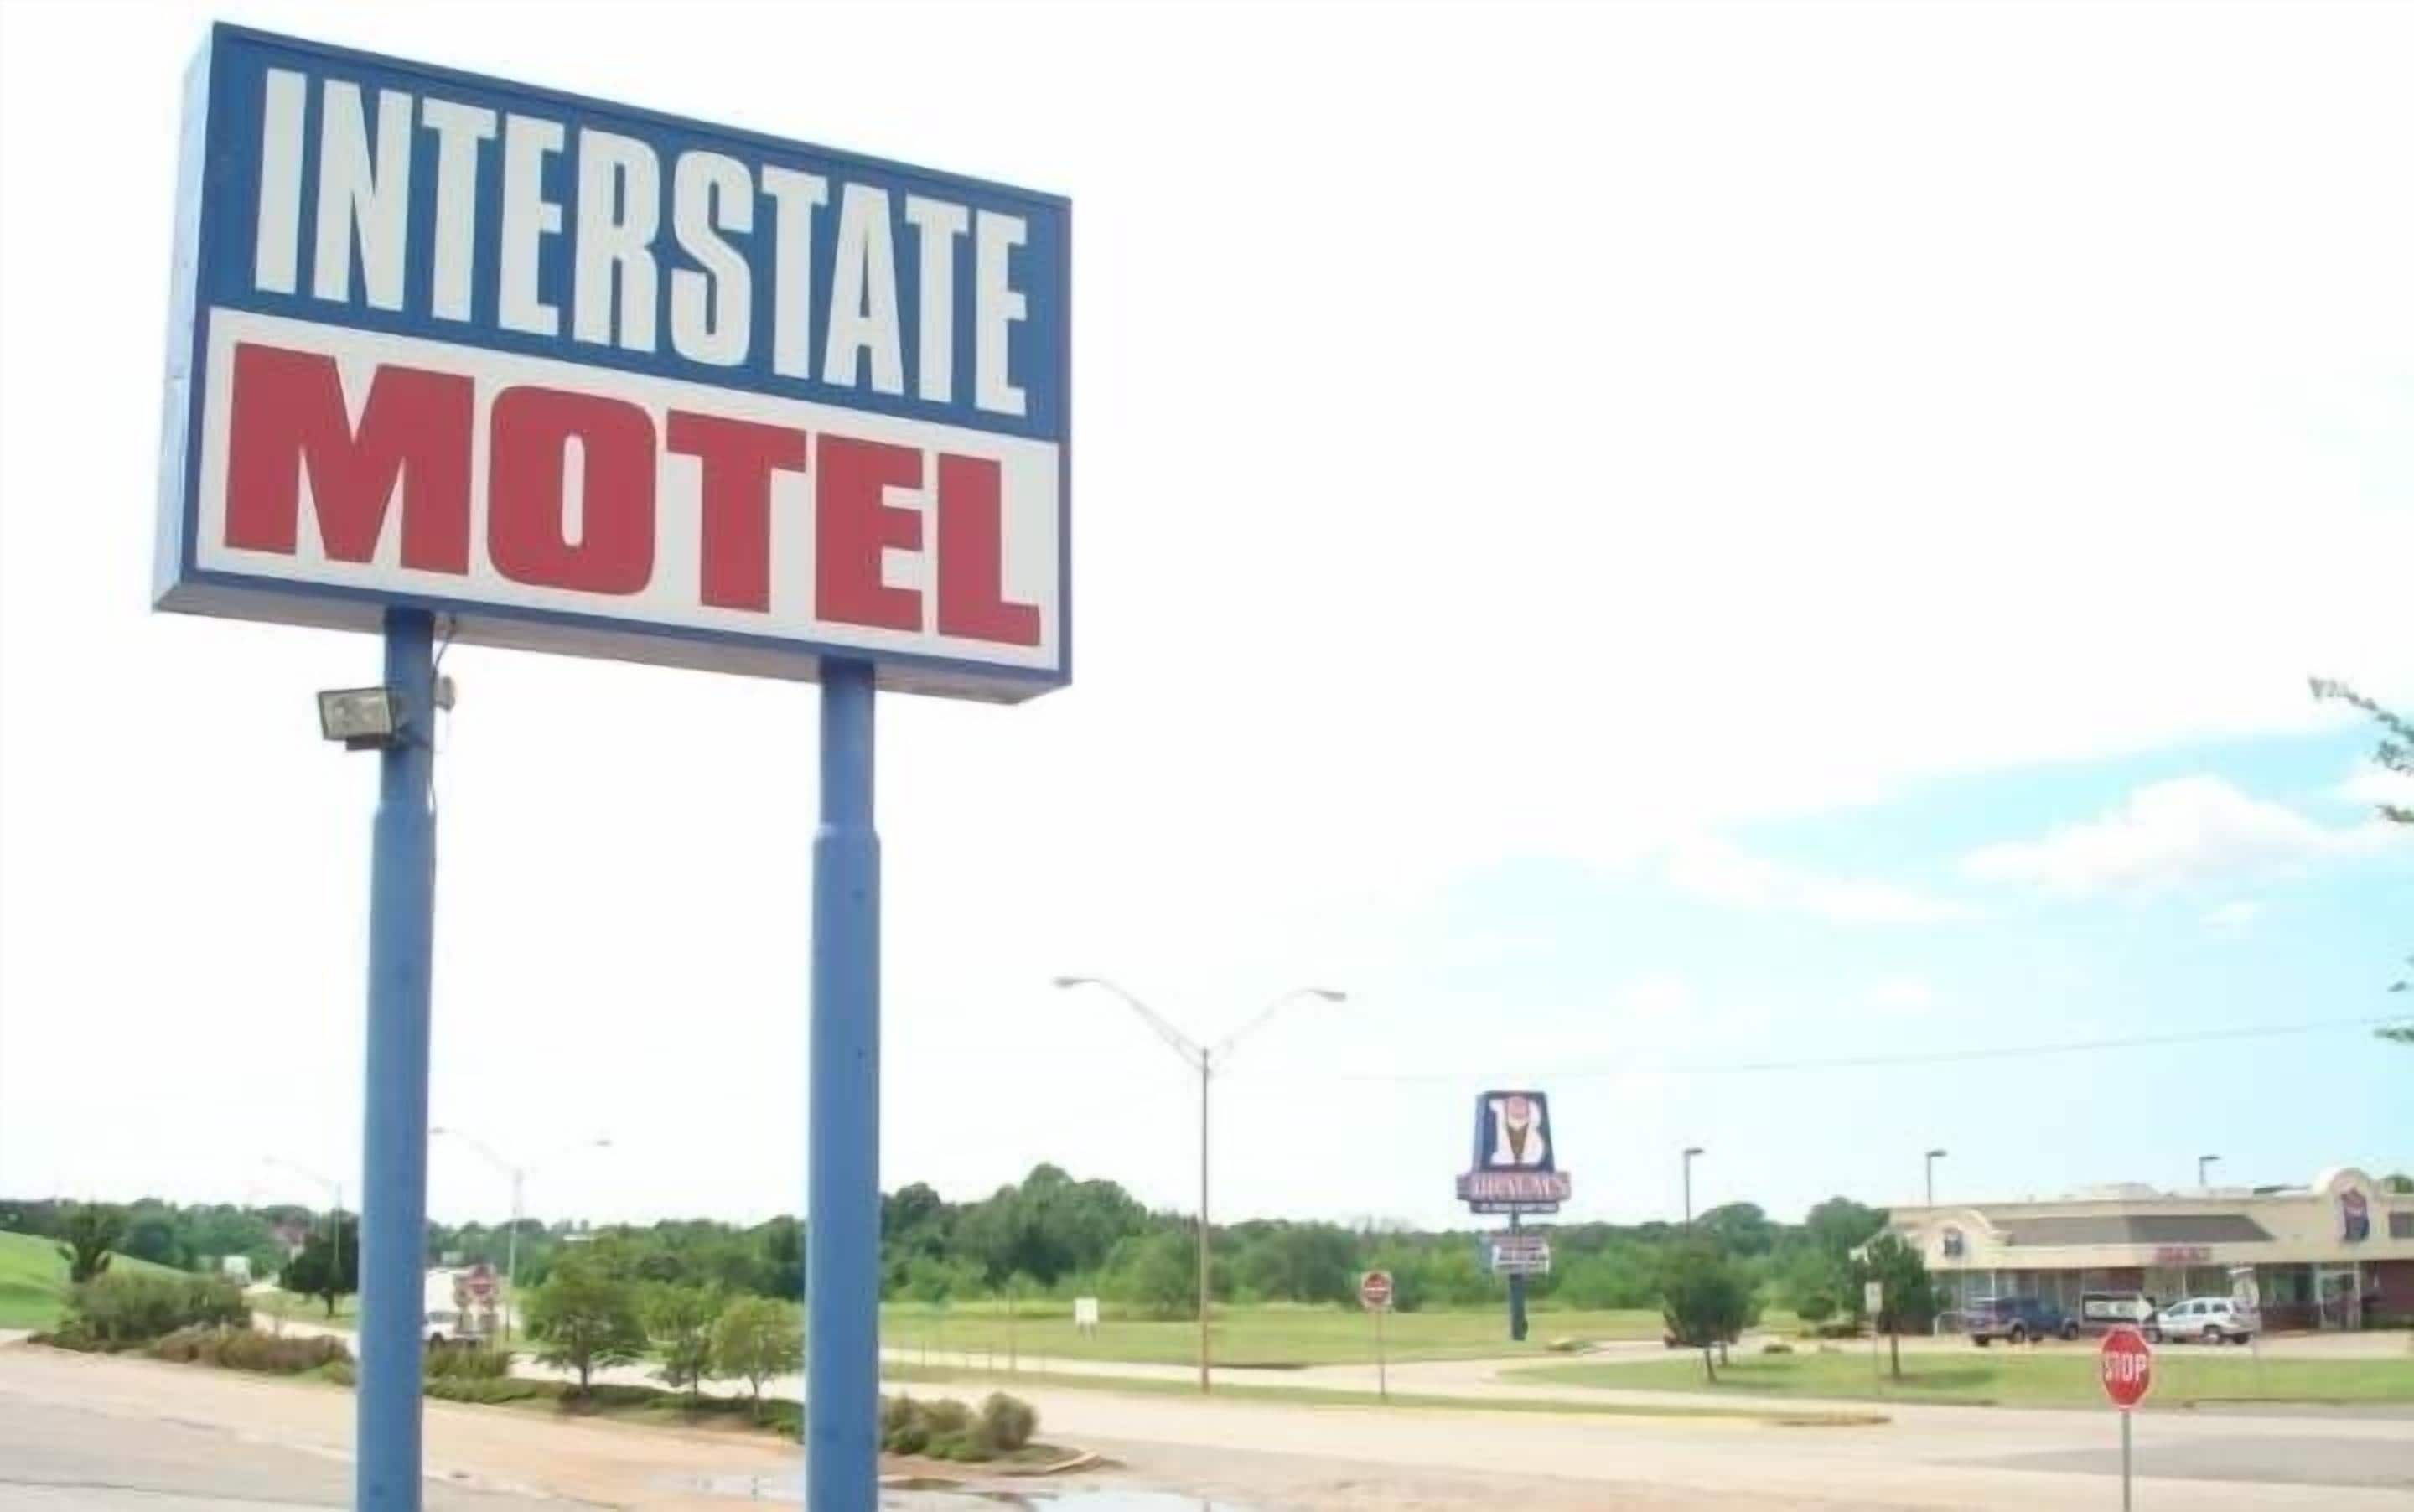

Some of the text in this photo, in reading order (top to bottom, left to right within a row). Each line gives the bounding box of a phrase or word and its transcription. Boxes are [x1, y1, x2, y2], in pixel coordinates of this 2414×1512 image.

[256, 69, 1028, 415] INTERSTATE
[225, 341, 1041, 646] MOTEL
[2104, 1352, 2147, 1382] STOP
